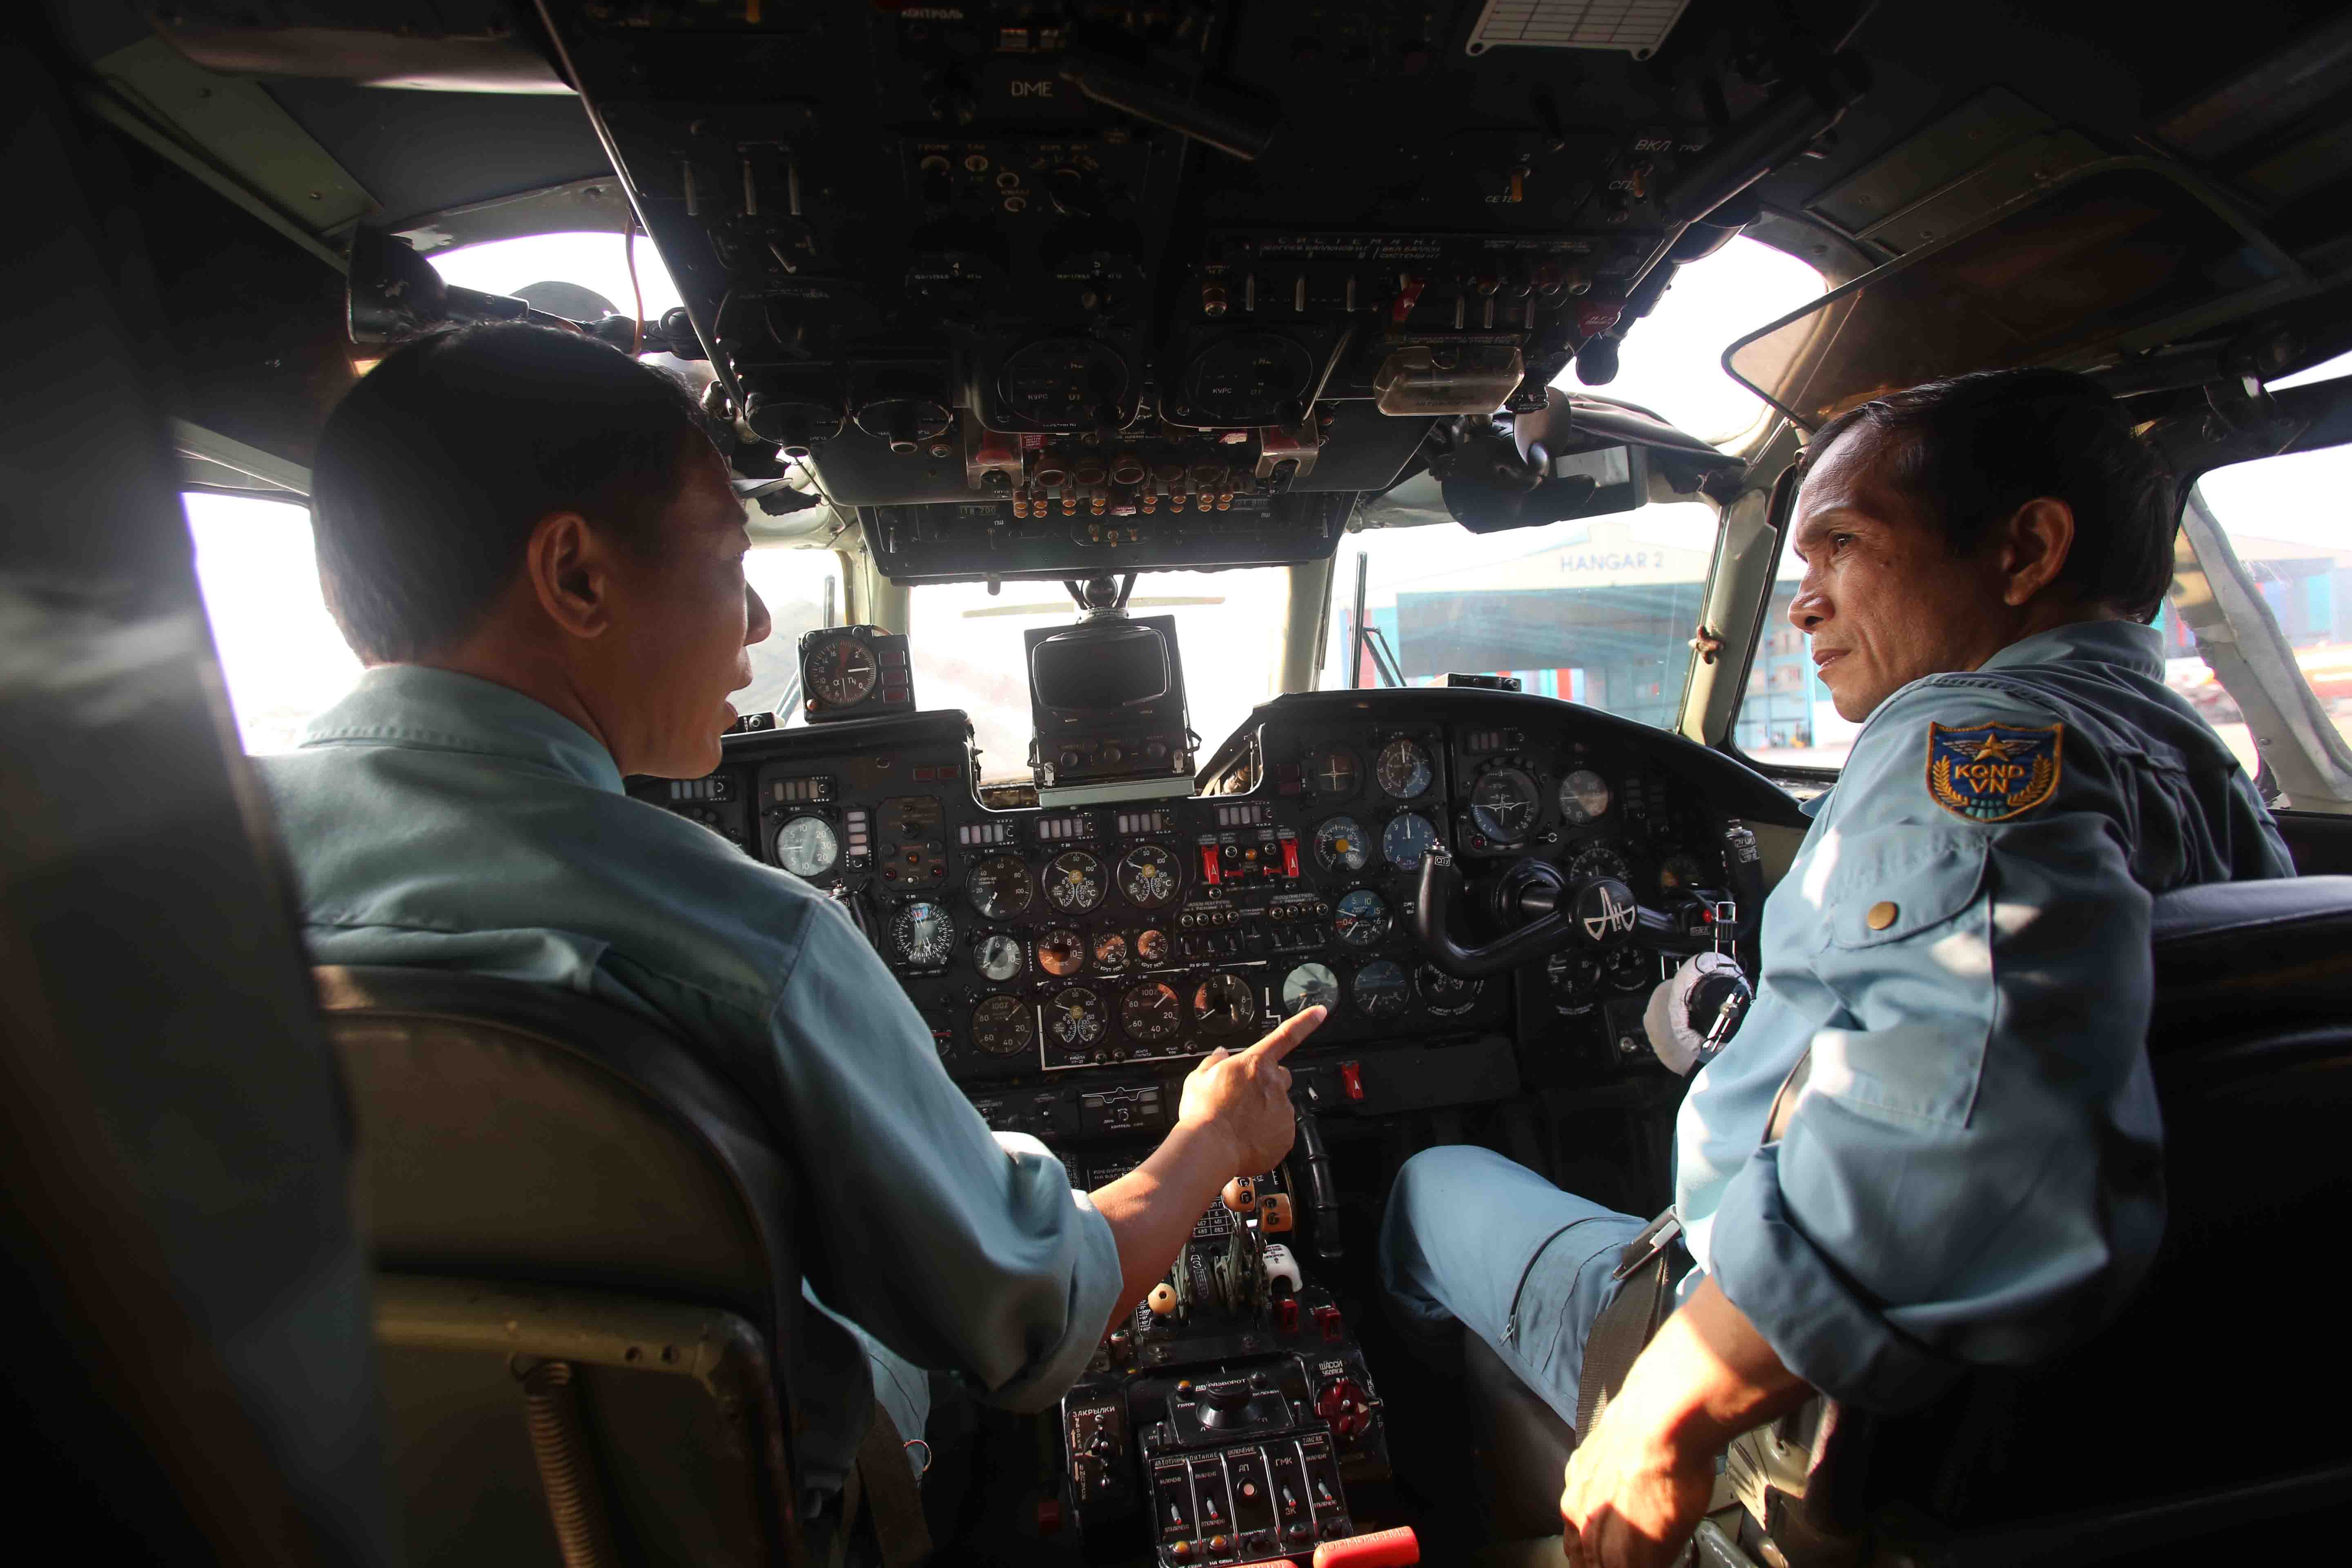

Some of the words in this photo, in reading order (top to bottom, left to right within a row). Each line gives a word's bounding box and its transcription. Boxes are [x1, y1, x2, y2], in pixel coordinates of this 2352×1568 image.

[1011, 80, 1052, 97] DME
[1635, 138, 1672, 151] ВКЛ
[1561, 551, 1648, 572] HANGAR
[1653, 550, 1664, 569] 2
[1955, 764, 2025, 779] KQND
[1969, 778, 2009, 794] VN
[822, 841, 832, 849] 30
[817, 853, 827, 862] 20
[801, 862, 810, 870] 10
[1319, 1360, 1343, 1370] ШАССИ
[1322, 1368, 1343, 1376] УБОРКА
[1208, 1379, 1246, 1387] РАЗВОРОТ
[1073, 1406, 1115, 1418] ЗАКРЫЛКИ
[1227, 1447, 1255, 1455] ВКЛЮЧЕНИЕ
[1190, 1452, 1218, 1461] ПИТАНИЕ
[1275, 1457, 1293, 1466] ГМК
[1238, 1464, 1250, 1472] АП
[1322, 1528, 1410, 1552] ТОРМОЖЕНИЕ
